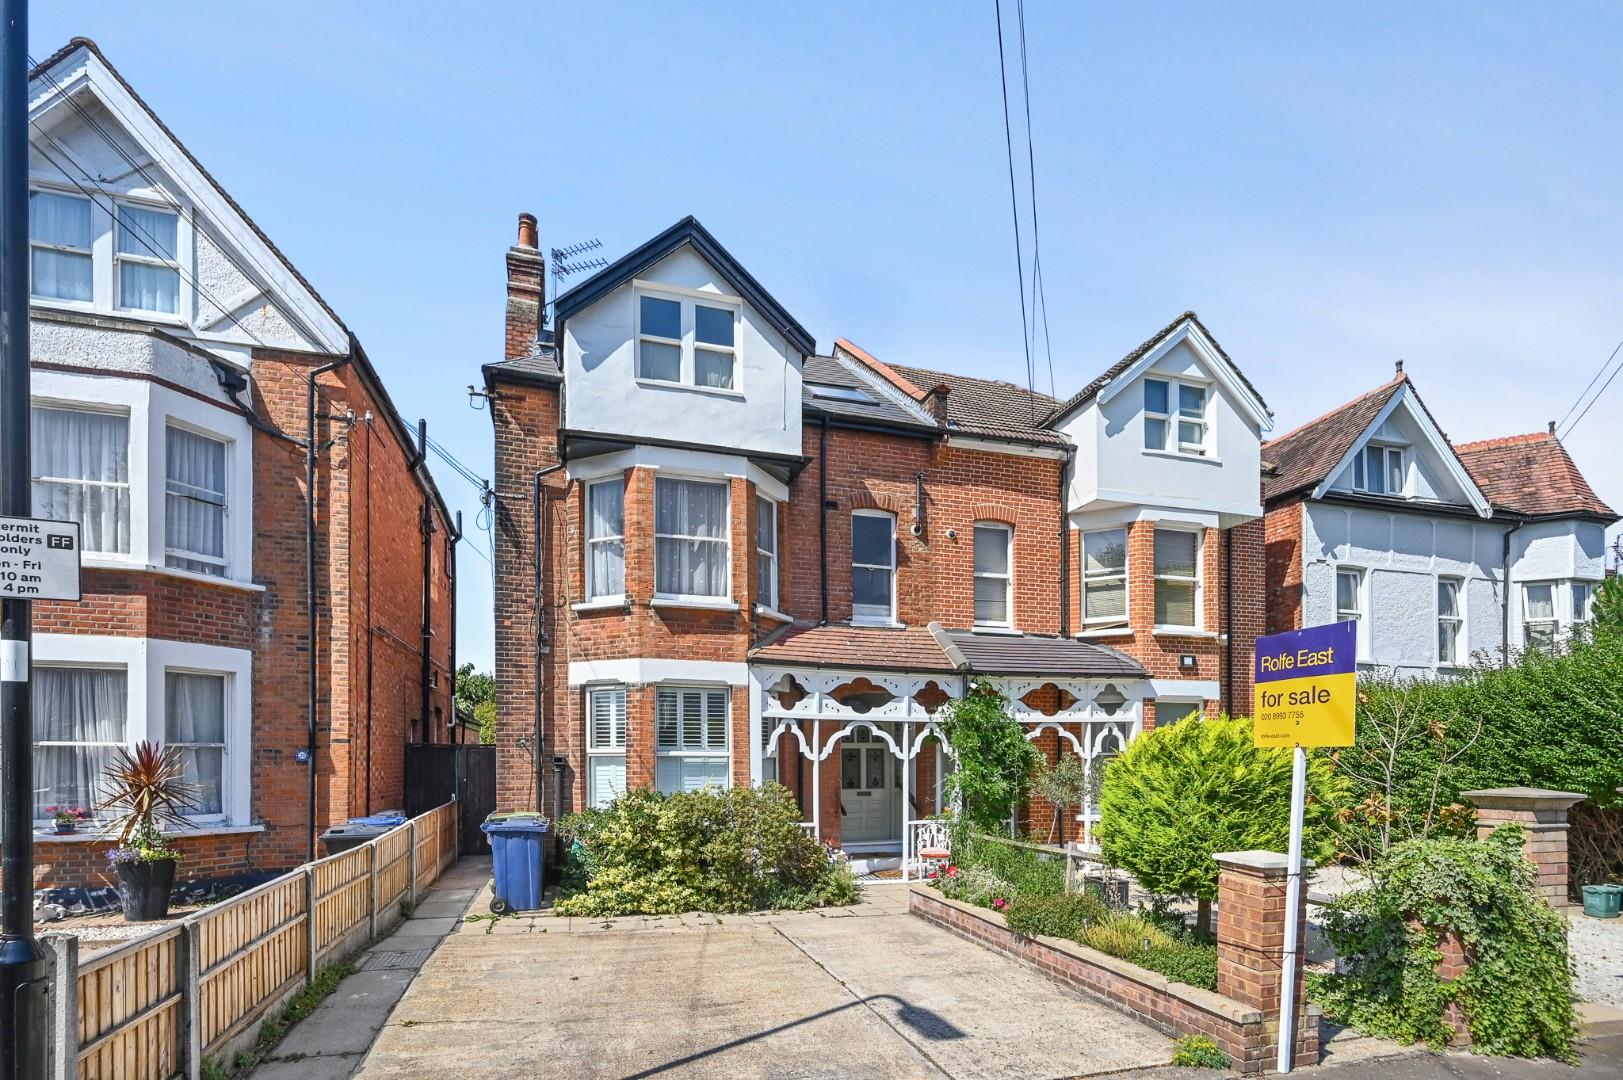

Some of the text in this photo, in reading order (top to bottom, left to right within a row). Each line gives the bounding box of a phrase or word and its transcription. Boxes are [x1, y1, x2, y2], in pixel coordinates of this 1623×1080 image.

[0, 524, 40, 533] ermit
[0, 533, 42, 544] olders
[51, 536, 71, 548] FF
[0, 546, 31, 556] only
[23, 560, 41, 570] Fri
[0, 571, 41, 583] 10 am
[3, 583, 39, 594] 4 pm
[1261, 647, 1334, 672] Rolfe East
[1261, 685, 1331, 708] for sale
[1260, 713, 1272, 721] 020
